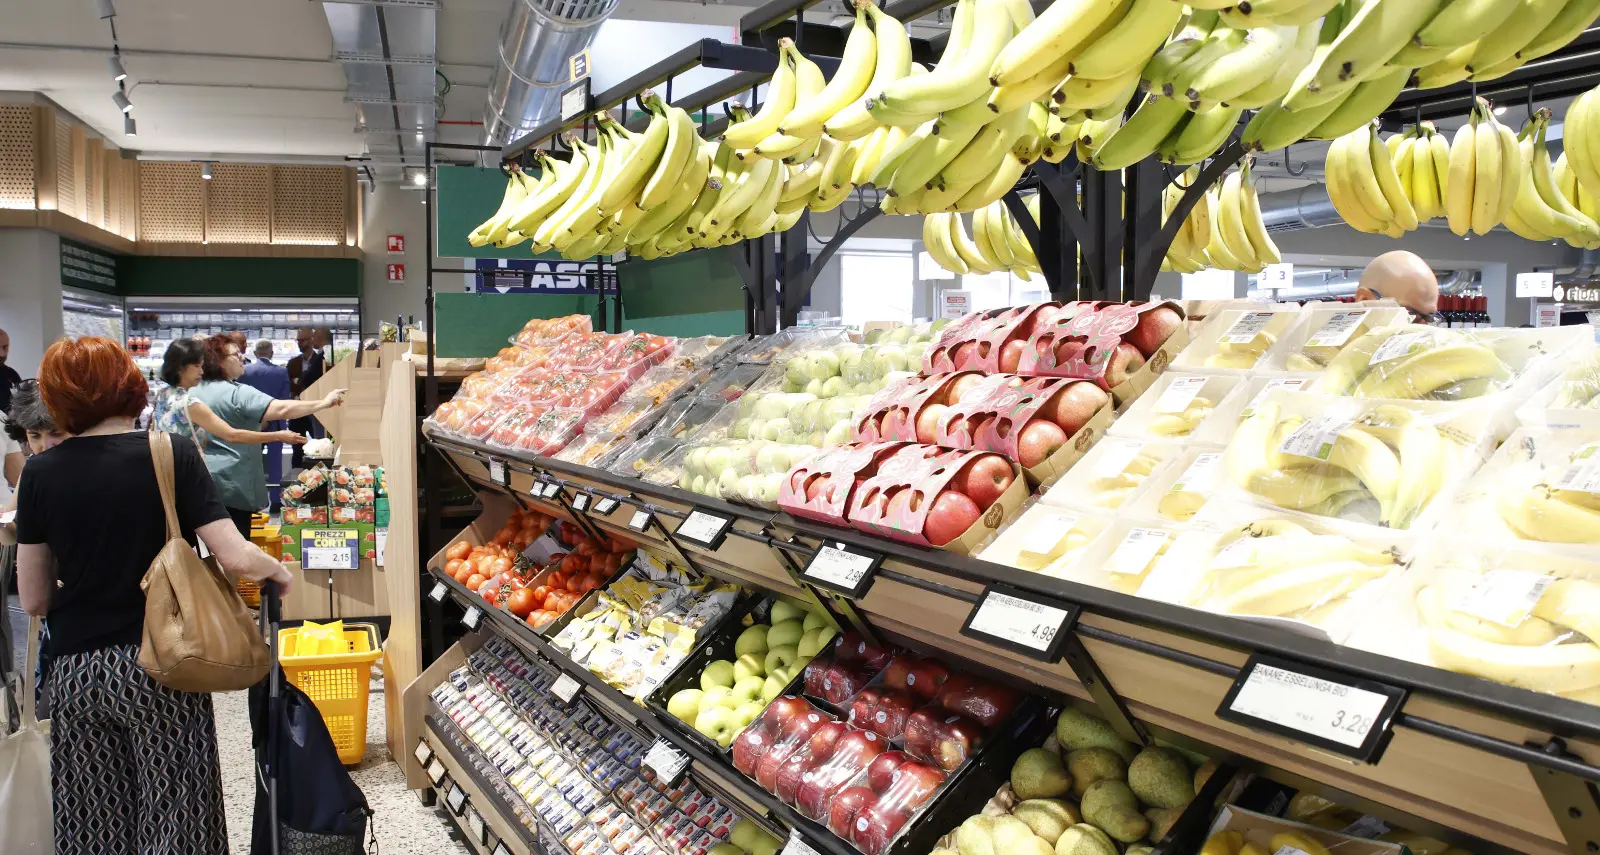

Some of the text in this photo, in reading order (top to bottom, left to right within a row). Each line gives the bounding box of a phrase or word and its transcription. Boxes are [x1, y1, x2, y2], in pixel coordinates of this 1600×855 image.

[1279, 270, 1286, 280] 3
[314, 539, 347, 548] CORTI
[1031, 624, 1056, 642] 4.98
[1253, 665, 1348, 697] BANANE ESSELUNGA BIO
[1331, 710, 1372, 735] 3.28
